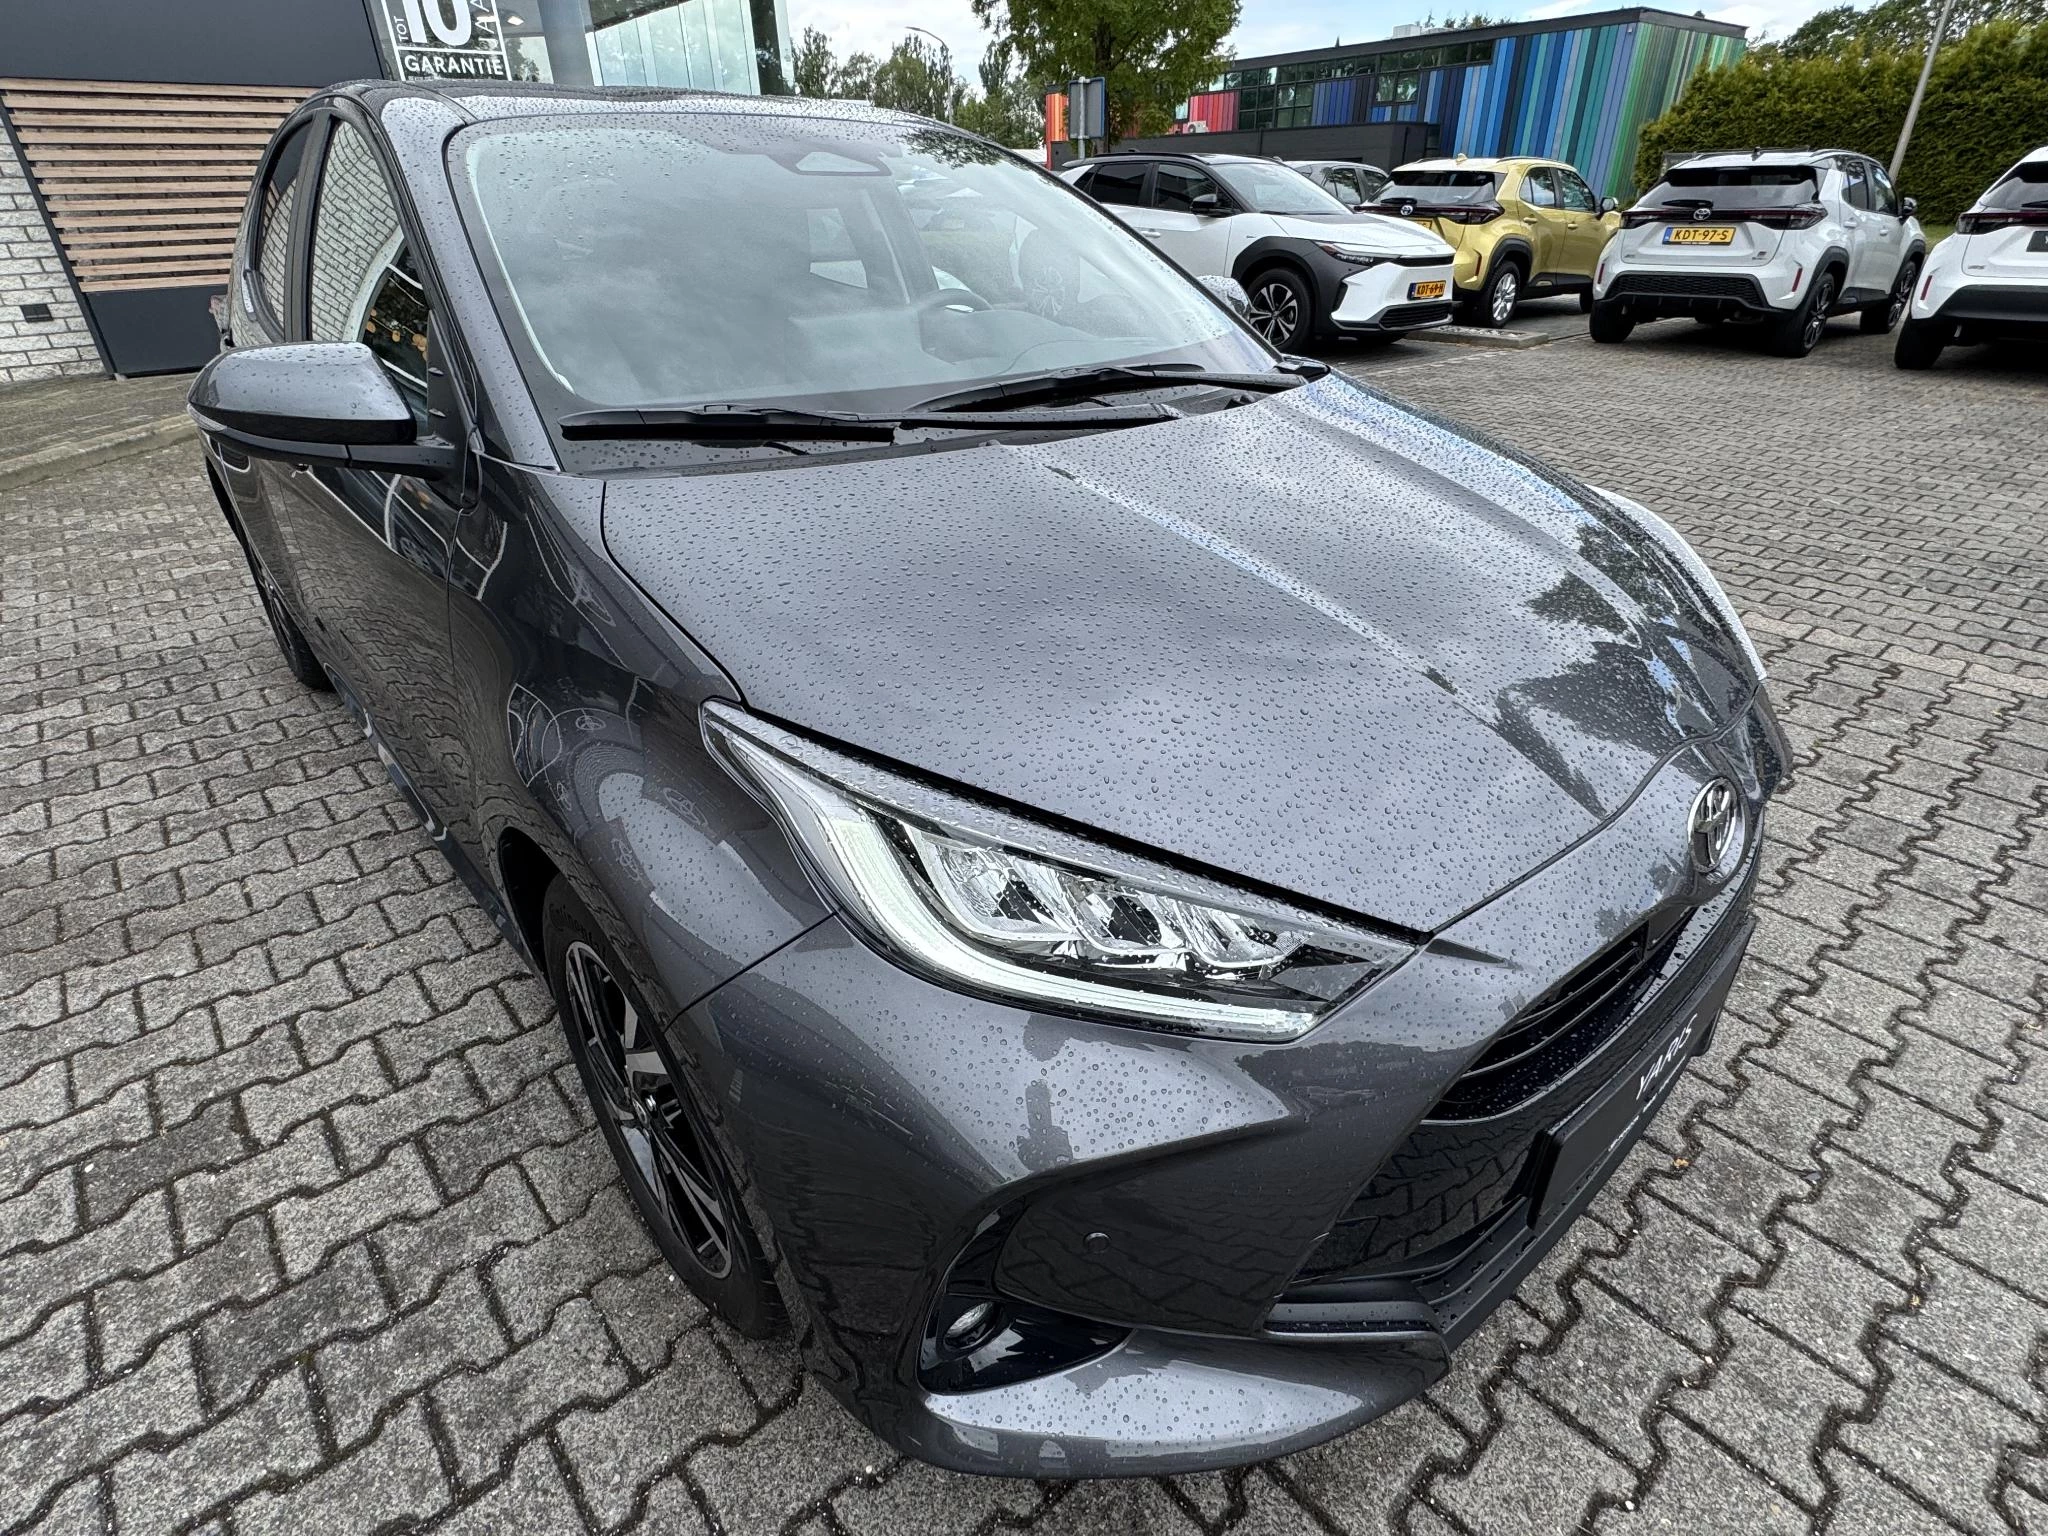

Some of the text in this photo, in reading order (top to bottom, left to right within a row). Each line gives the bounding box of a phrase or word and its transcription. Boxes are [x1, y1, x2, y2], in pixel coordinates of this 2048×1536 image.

[394, 16, 409, 41] TOT
[470, 0, 499, 50] JAA
[404, 55, 504, 75] GARANTIE
[1674, 229, 1728, 240] KDT-97-S
[1416, 283, 1444, 295] KDT-69-H
[1636, 1012, 1698, 1101] YARIS
